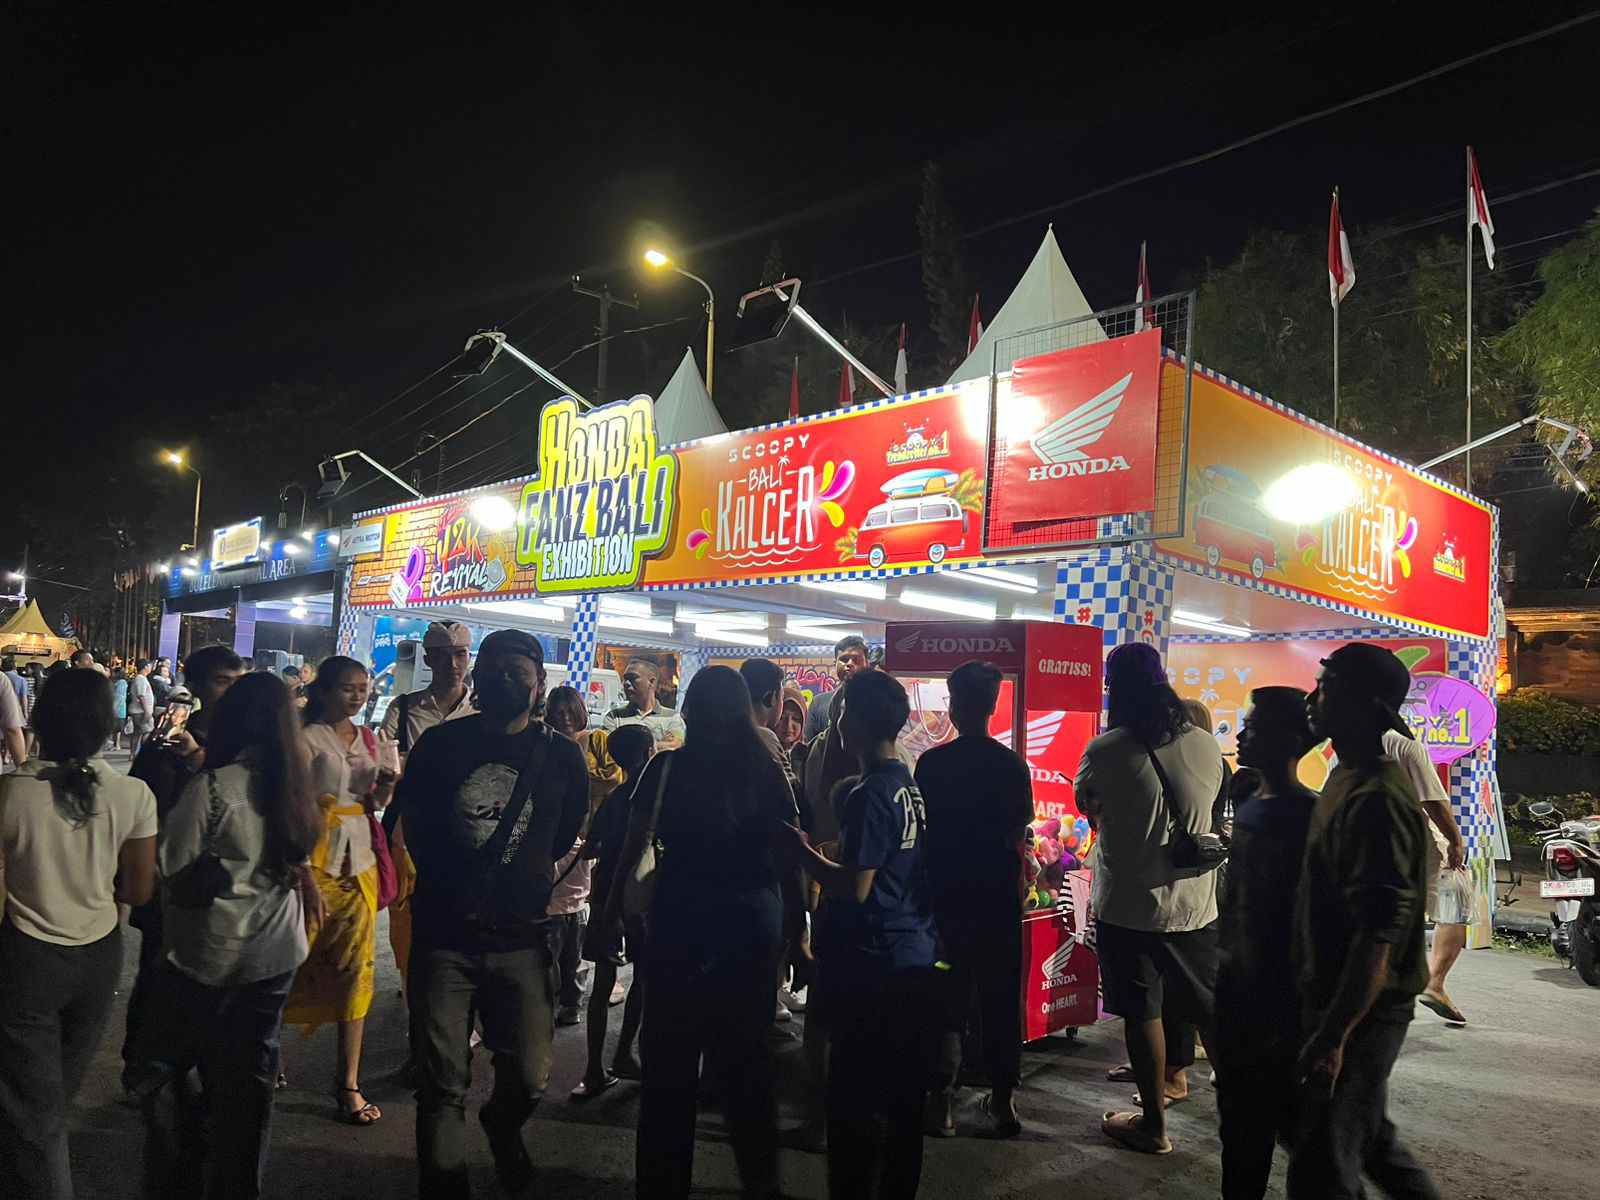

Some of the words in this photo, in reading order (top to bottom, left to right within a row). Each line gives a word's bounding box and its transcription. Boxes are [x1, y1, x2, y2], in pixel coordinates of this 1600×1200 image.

[543, 410, 650, 491] HONDA
[728, 433, 811, 463] SCOOPY
[748, 457, 790, 492] BALI
[1028, 455, 1131, 482] HONDA
[522, 481, 590, 553] FANZ
[595, 467, 667, 538] BALI
[716, 466, 815, 552] KALCER
[269, 558, 296, 581] AREA
[541, 533, 635, 582] EXHIBITION
[920, 637, 1016, 653] HONDA
[1038, 658, 1092, 677] GRATISS!
[1035, 800, 1065, 817] ART
[1041, 974, 1077, 990] HONDA
